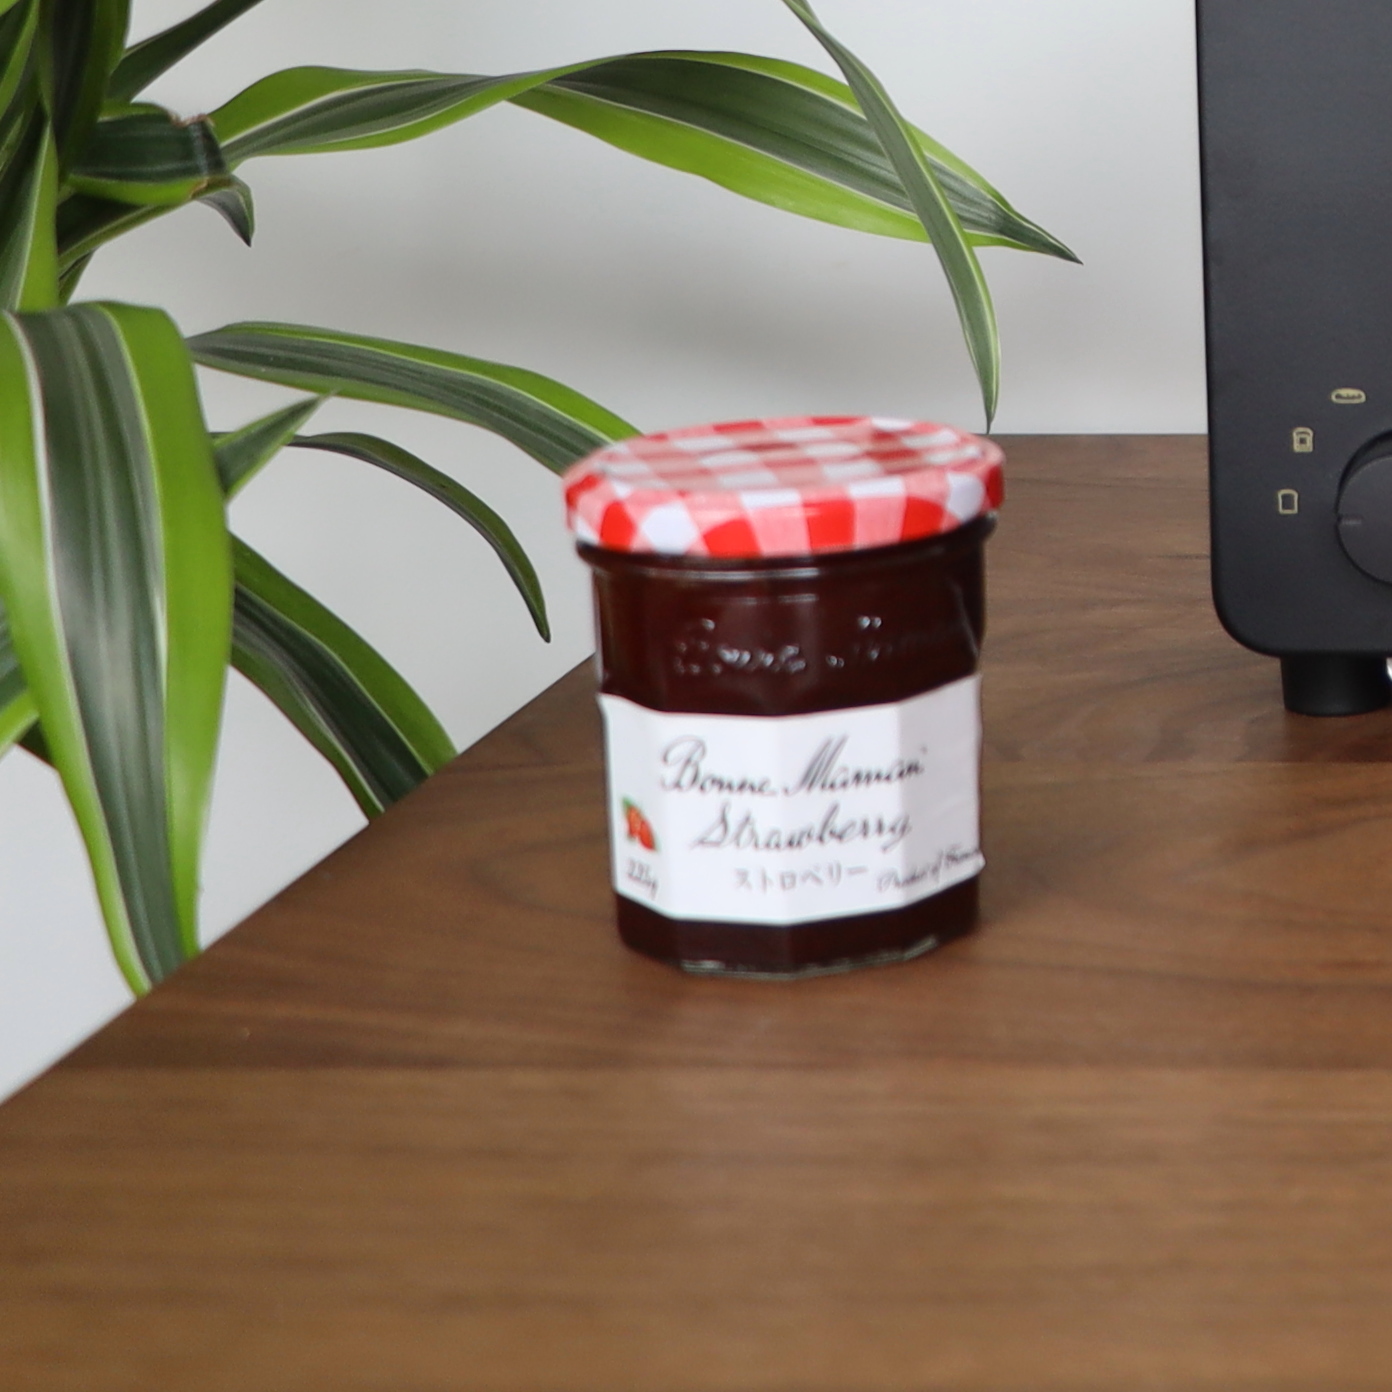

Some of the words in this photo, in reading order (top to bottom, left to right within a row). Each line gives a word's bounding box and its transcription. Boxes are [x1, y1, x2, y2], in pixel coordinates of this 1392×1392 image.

[660, 734, 778, 796] Bonne
[784, 733, 924, 796] Maman
[691, 802, 913, 853] Strawberry
[734, 861, 869, 892] ストロベリー
